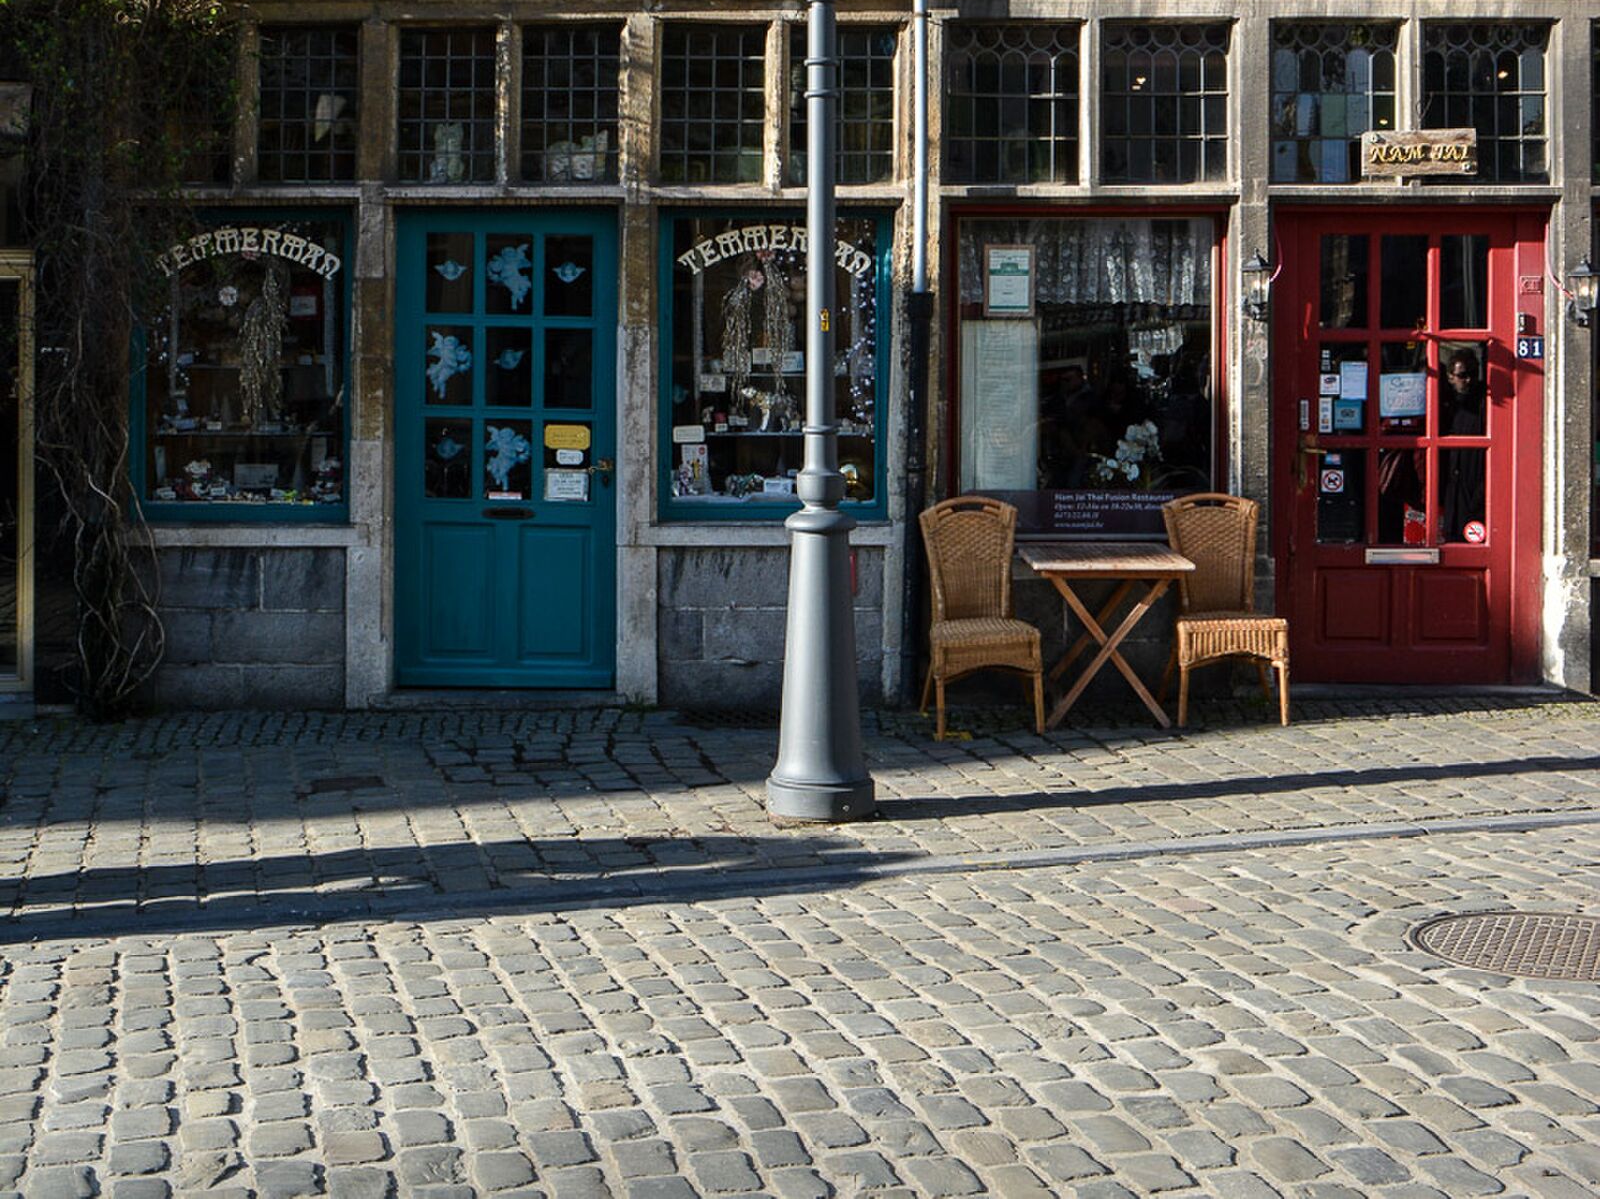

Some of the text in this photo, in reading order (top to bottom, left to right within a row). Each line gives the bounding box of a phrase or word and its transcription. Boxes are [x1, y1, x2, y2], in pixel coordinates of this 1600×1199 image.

[1369, 142, 1426, 163] NAM
[154, 227, 341, 280] TEMMERMAN
[677, 224, 872, 278] TEMMERAN
[1518, 340, 1542, 357] 81
[1054, 493, 1074, 501] Nam
[1087, 492, 1103, 501] Thai
[1105, 492, 1130, 501] Fusion
[1132, 492, 1174, 501] Restaurant
